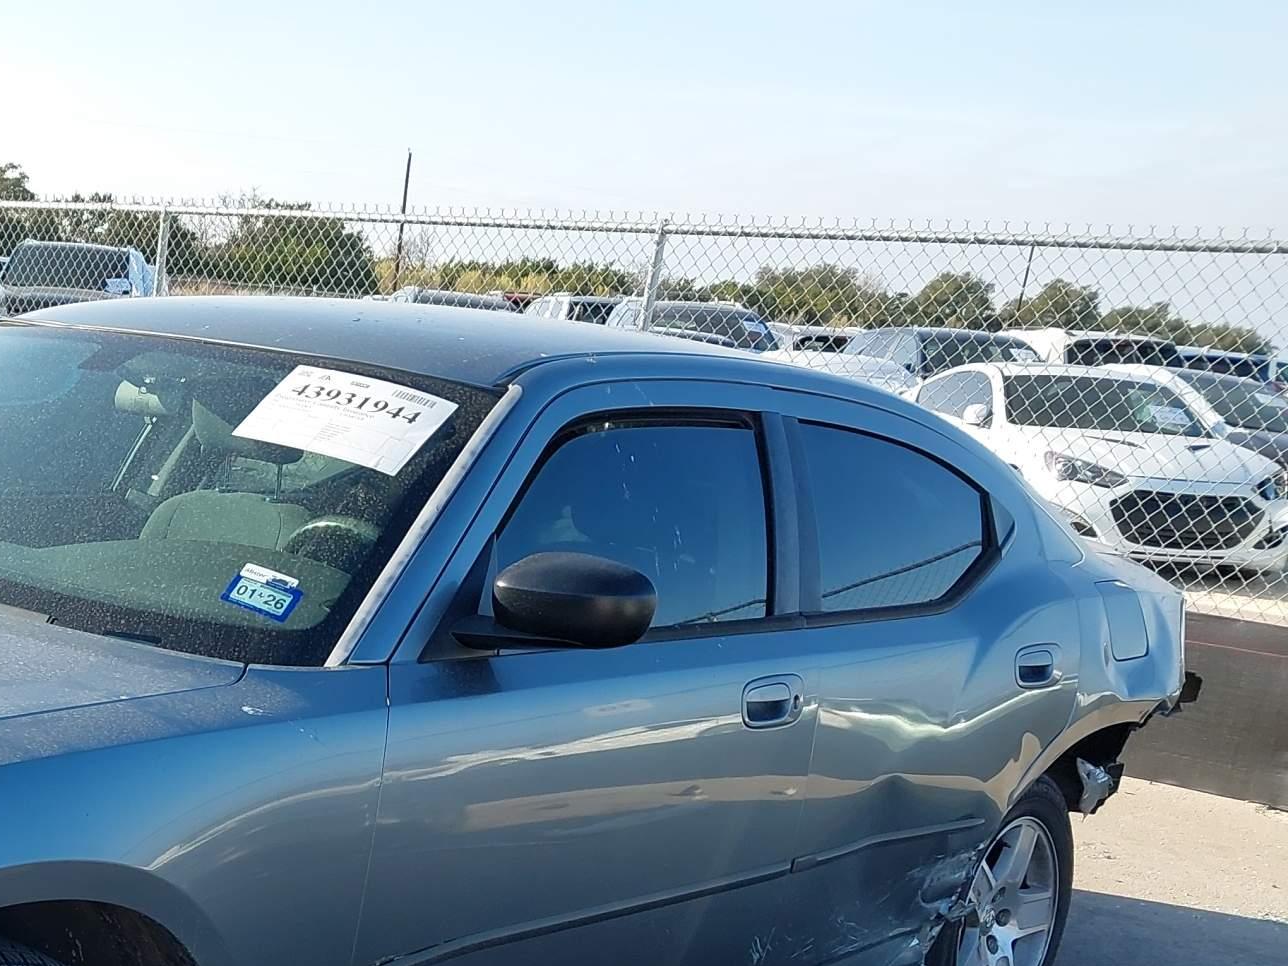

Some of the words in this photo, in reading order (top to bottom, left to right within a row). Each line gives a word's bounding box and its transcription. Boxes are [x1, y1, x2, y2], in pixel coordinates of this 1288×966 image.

[292, 383, 423, 424] 43931944
[236, 584, 257, 599] 01
[263, 594, 287, 610] 26
